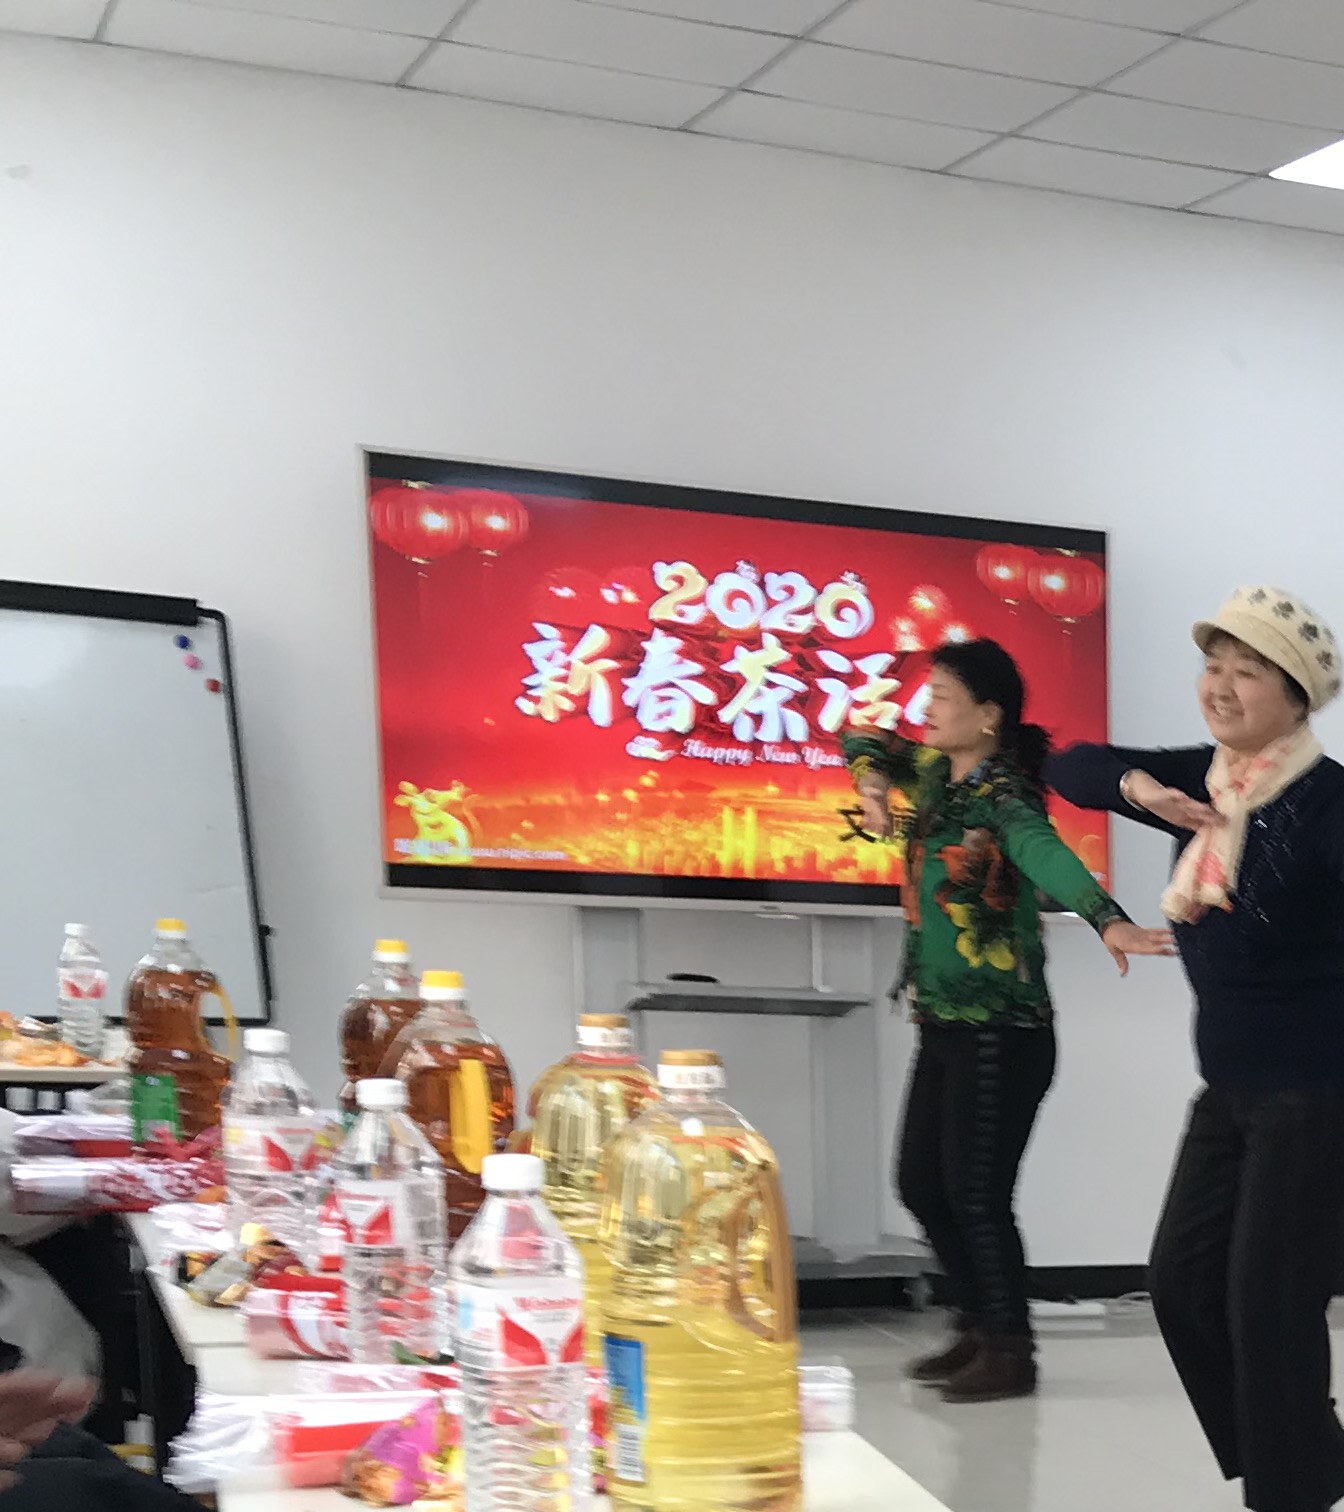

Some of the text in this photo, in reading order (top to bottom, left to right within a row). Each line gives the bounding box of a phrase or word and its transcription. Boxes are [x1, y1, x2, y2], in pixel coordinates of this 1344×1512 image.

[649, 560, 874, 638] 2020
[514, 621, 932, 743] 新春茶话
[681, 738, 753, 767] Happy
[755, 744, 801, 764] New
